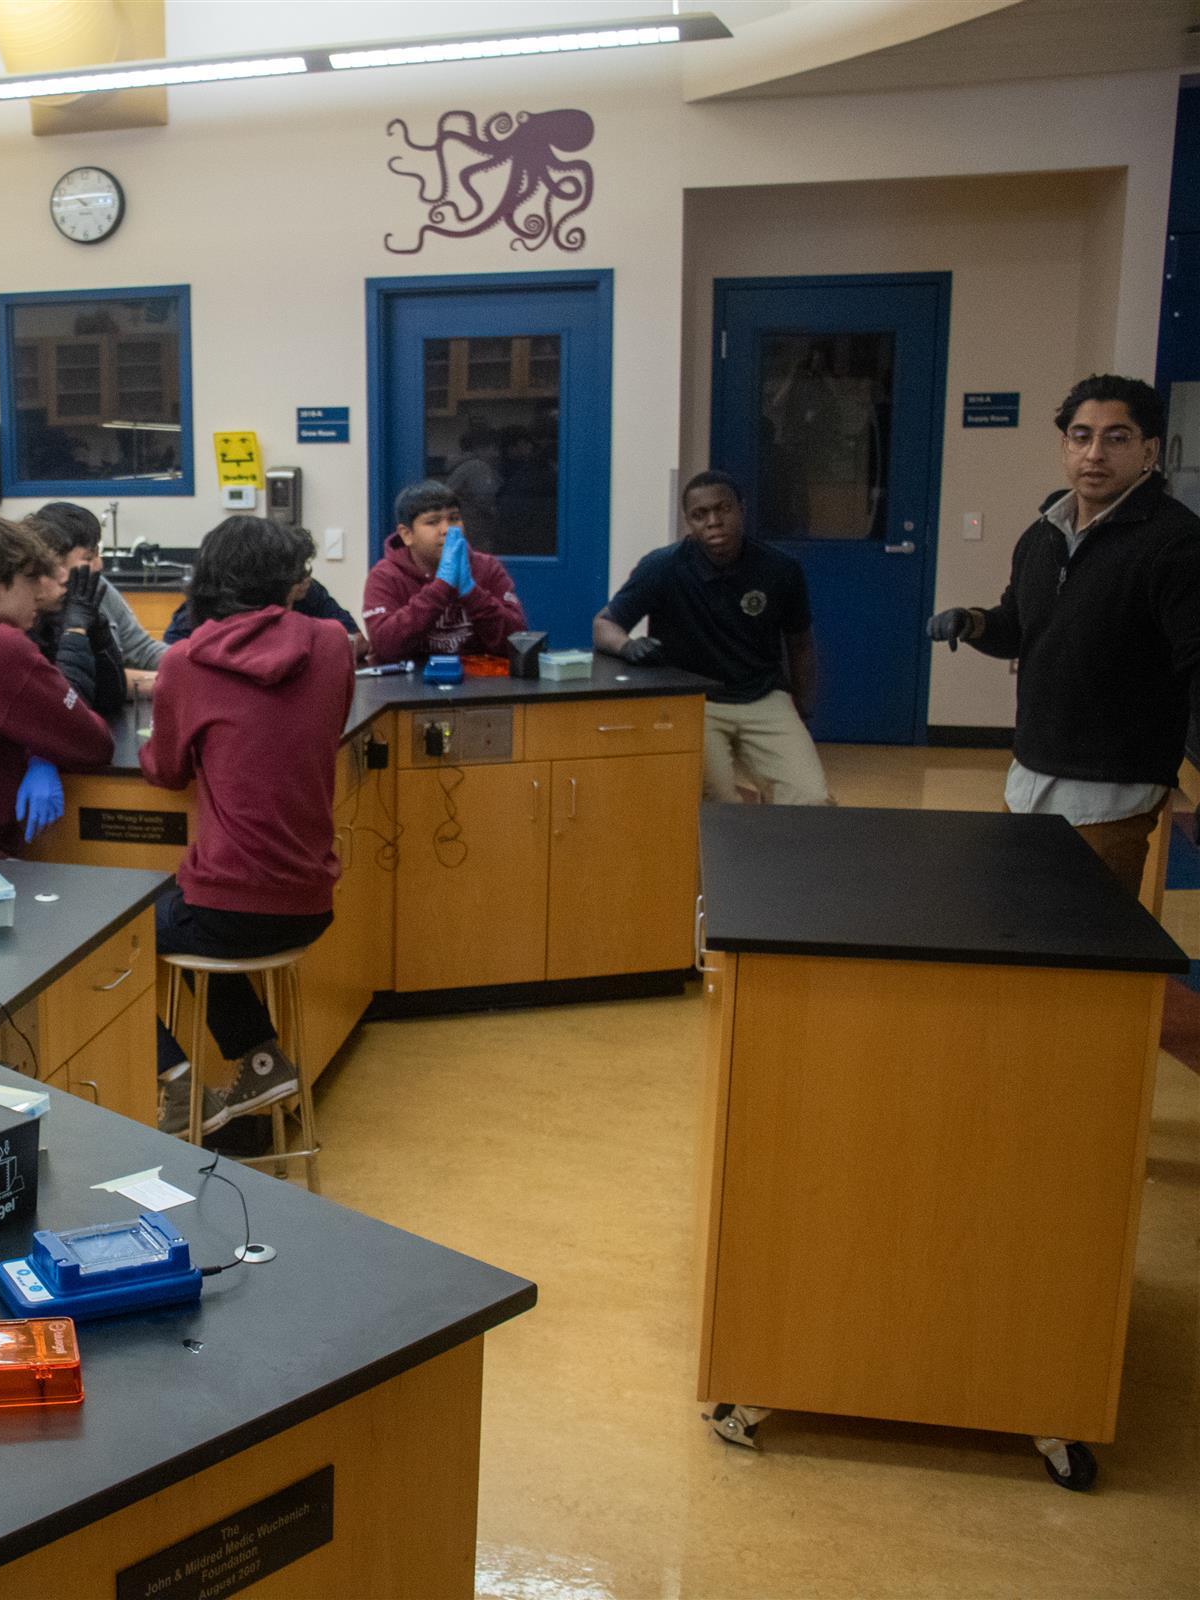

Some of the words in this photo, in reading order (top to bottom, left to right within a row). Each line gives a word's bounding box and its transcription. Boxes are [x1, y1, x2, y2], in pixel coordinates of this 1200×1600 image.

[221, 1524, 240, 1541] The
[145, 1575, 171, 1597] John
[174, 1569, 182, 1582] &
[185, 1547, 223, 1577] Mildred
[225, 1532, 255, 1556] Medic
[201, 1546, 259, 1583] Foundation
[198, 1573, 237, 1600] August
